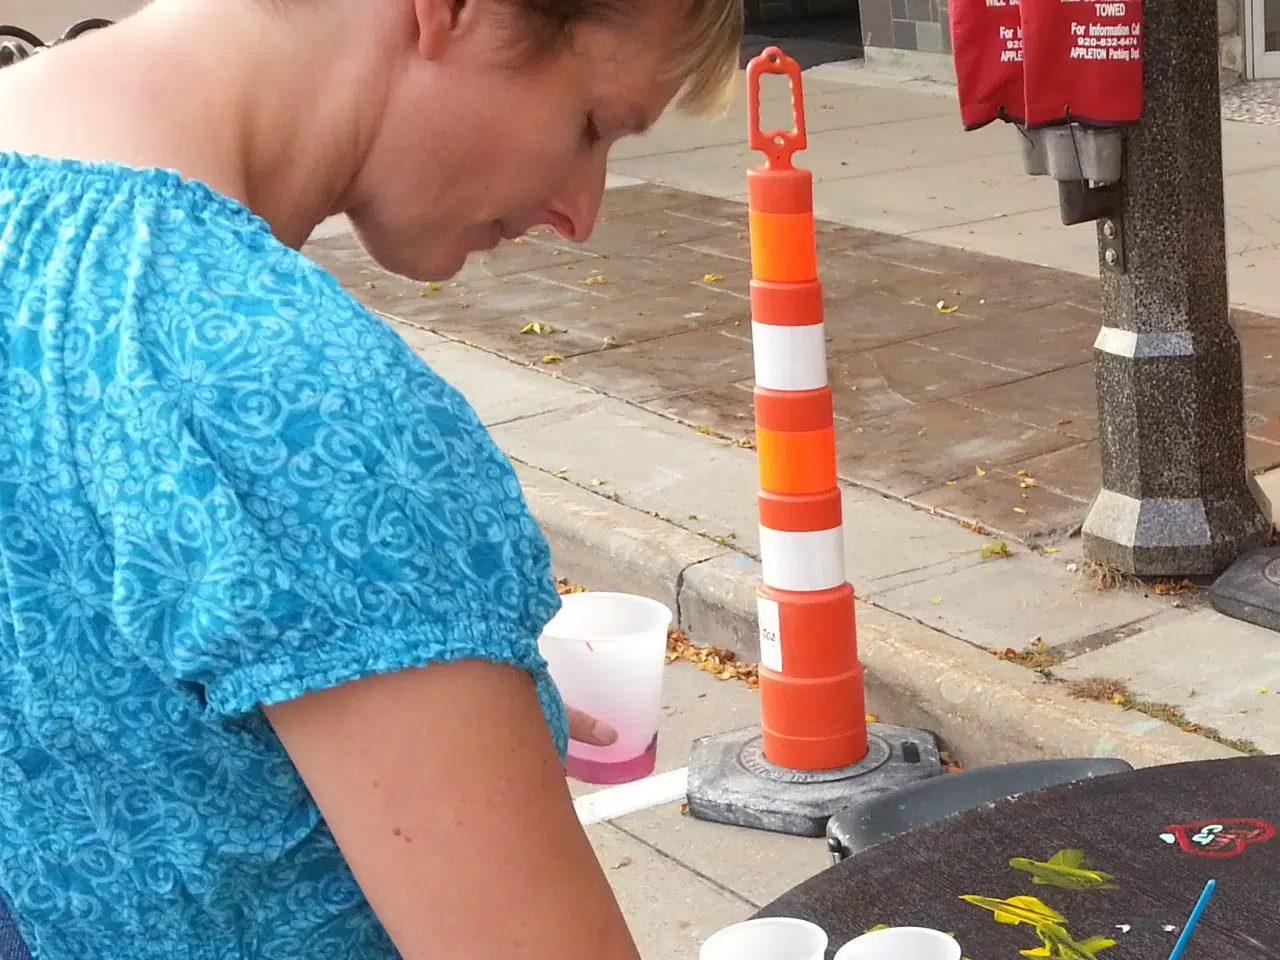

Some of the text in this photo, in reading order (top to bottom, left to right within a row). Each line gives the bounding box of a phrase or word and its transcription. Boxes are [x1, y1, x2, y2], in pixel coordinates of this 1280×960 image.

[1095, 3, 1126, 17] TOWED
[999, 26, 1014, 39] For
[1071, 22, 1086, 35] For
[1089, 23, 1130, 36] Information
[1070, 47, 1107, 60] APPLETON
[1108, 48, 1130, 62] Parking
